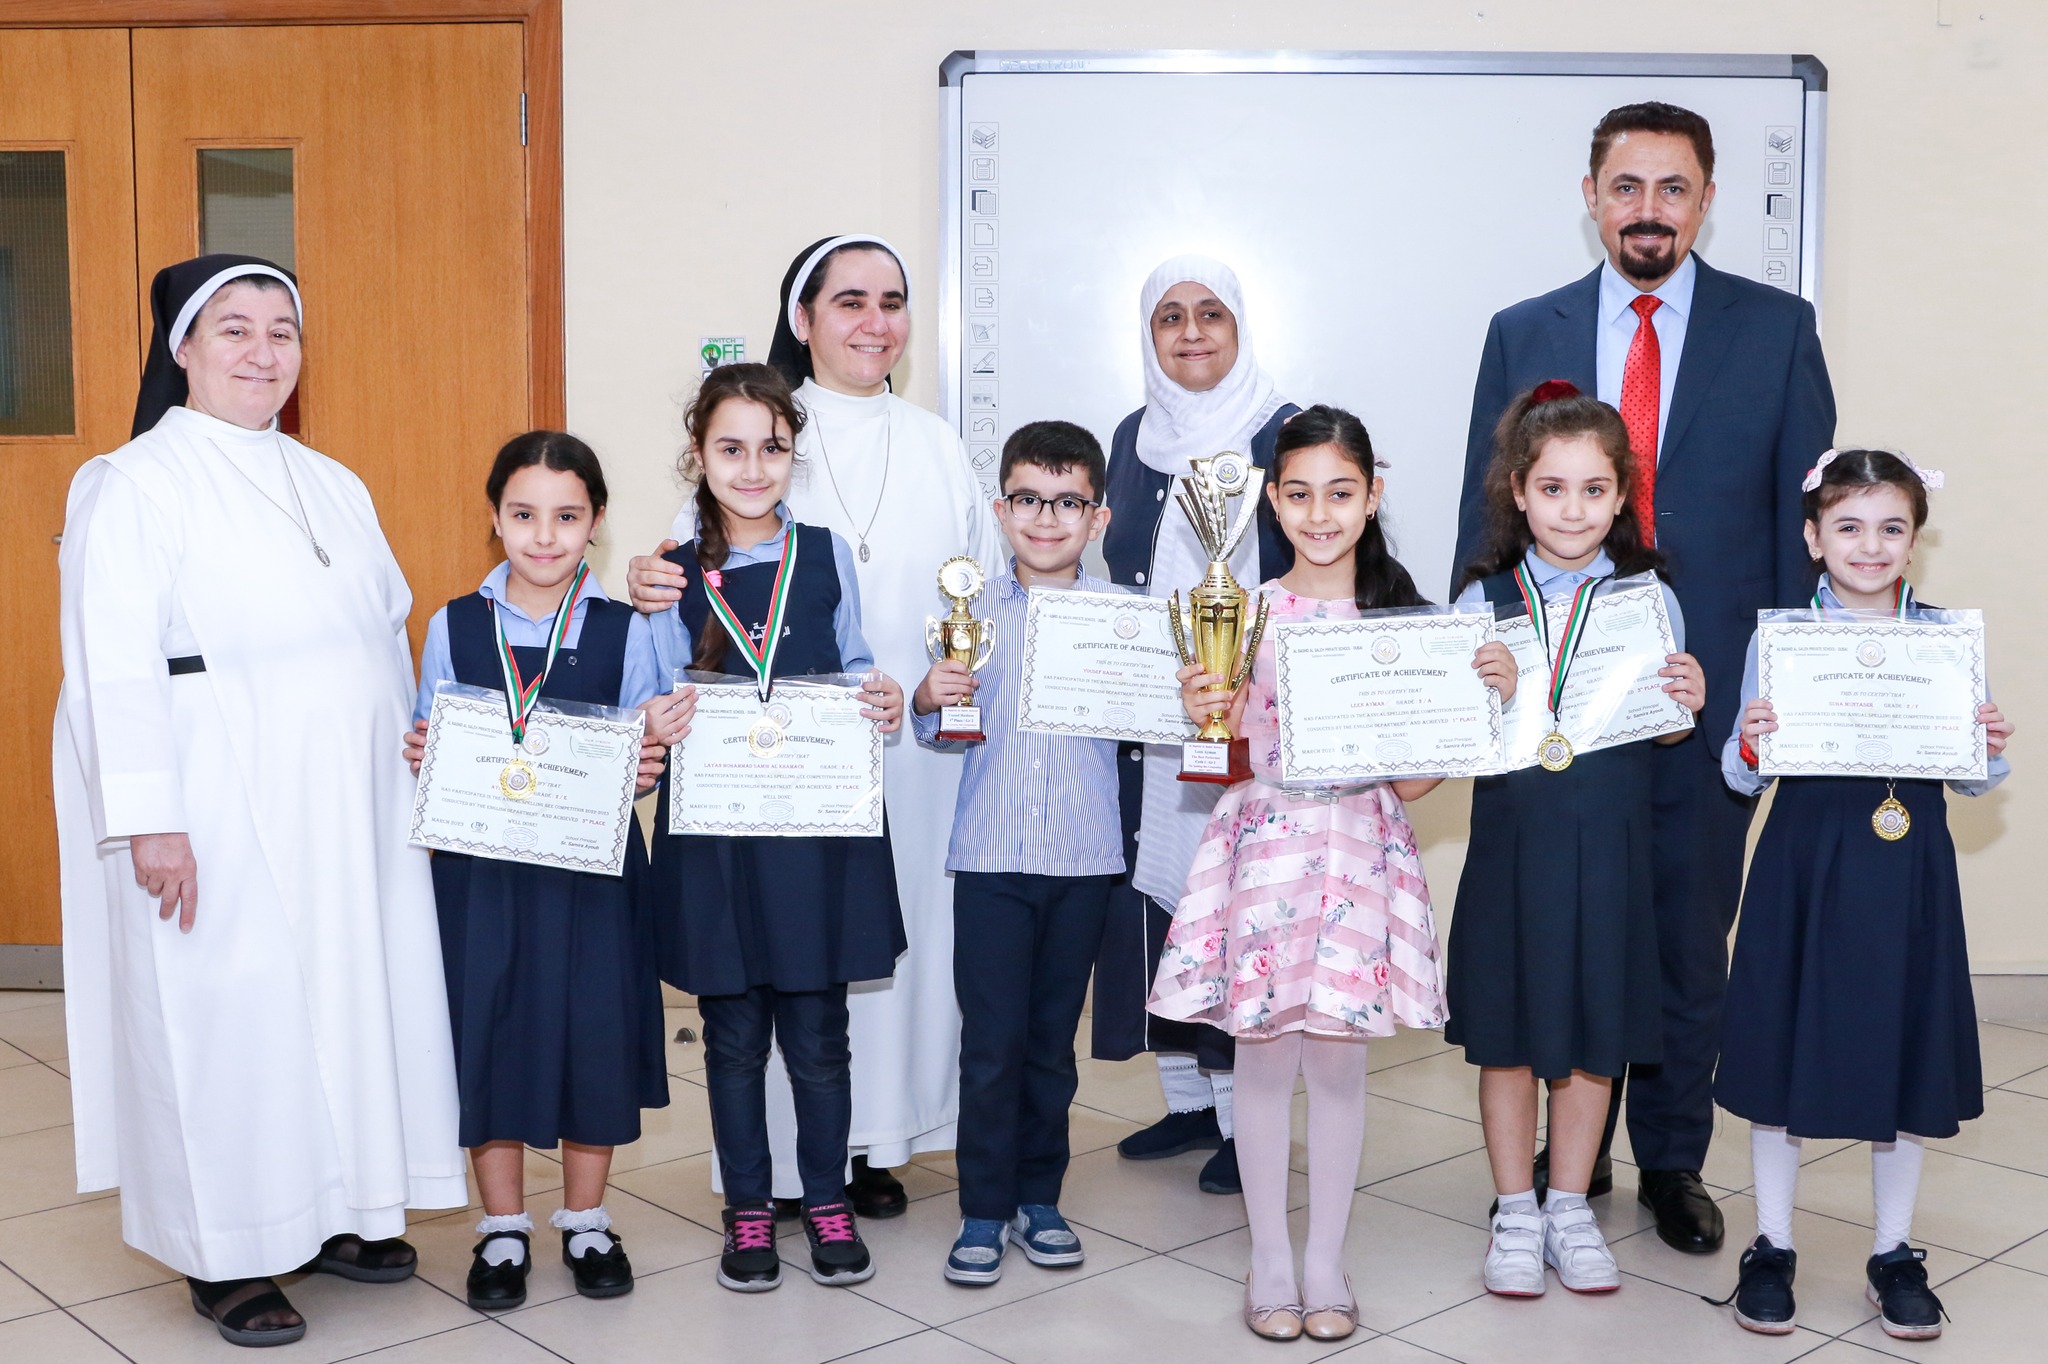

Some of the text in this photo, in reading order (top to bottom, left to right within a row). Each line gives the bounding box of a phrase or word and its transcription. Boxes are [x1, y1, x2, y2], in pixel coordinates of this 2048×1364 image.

[701, 344, 745, 361] OFF
[1130, 645, 1179, 658] ACHIEVEMENT
[1575, 645, 1625, 659] ACHIEVEMENT
[1330, 670, 1380, 684] CERTIFICATE
[1393, 668, 1447, 677] ACHIEVEMENT
[1813, 672, 1863, 682] CERTIFICATE
[1877, 673, 1932, 684] ACHIEVEMENT
[784, 735, 835, 745] ACHIEVEMENT
[536, 762, 588, 778] ACHIEVEMENT
